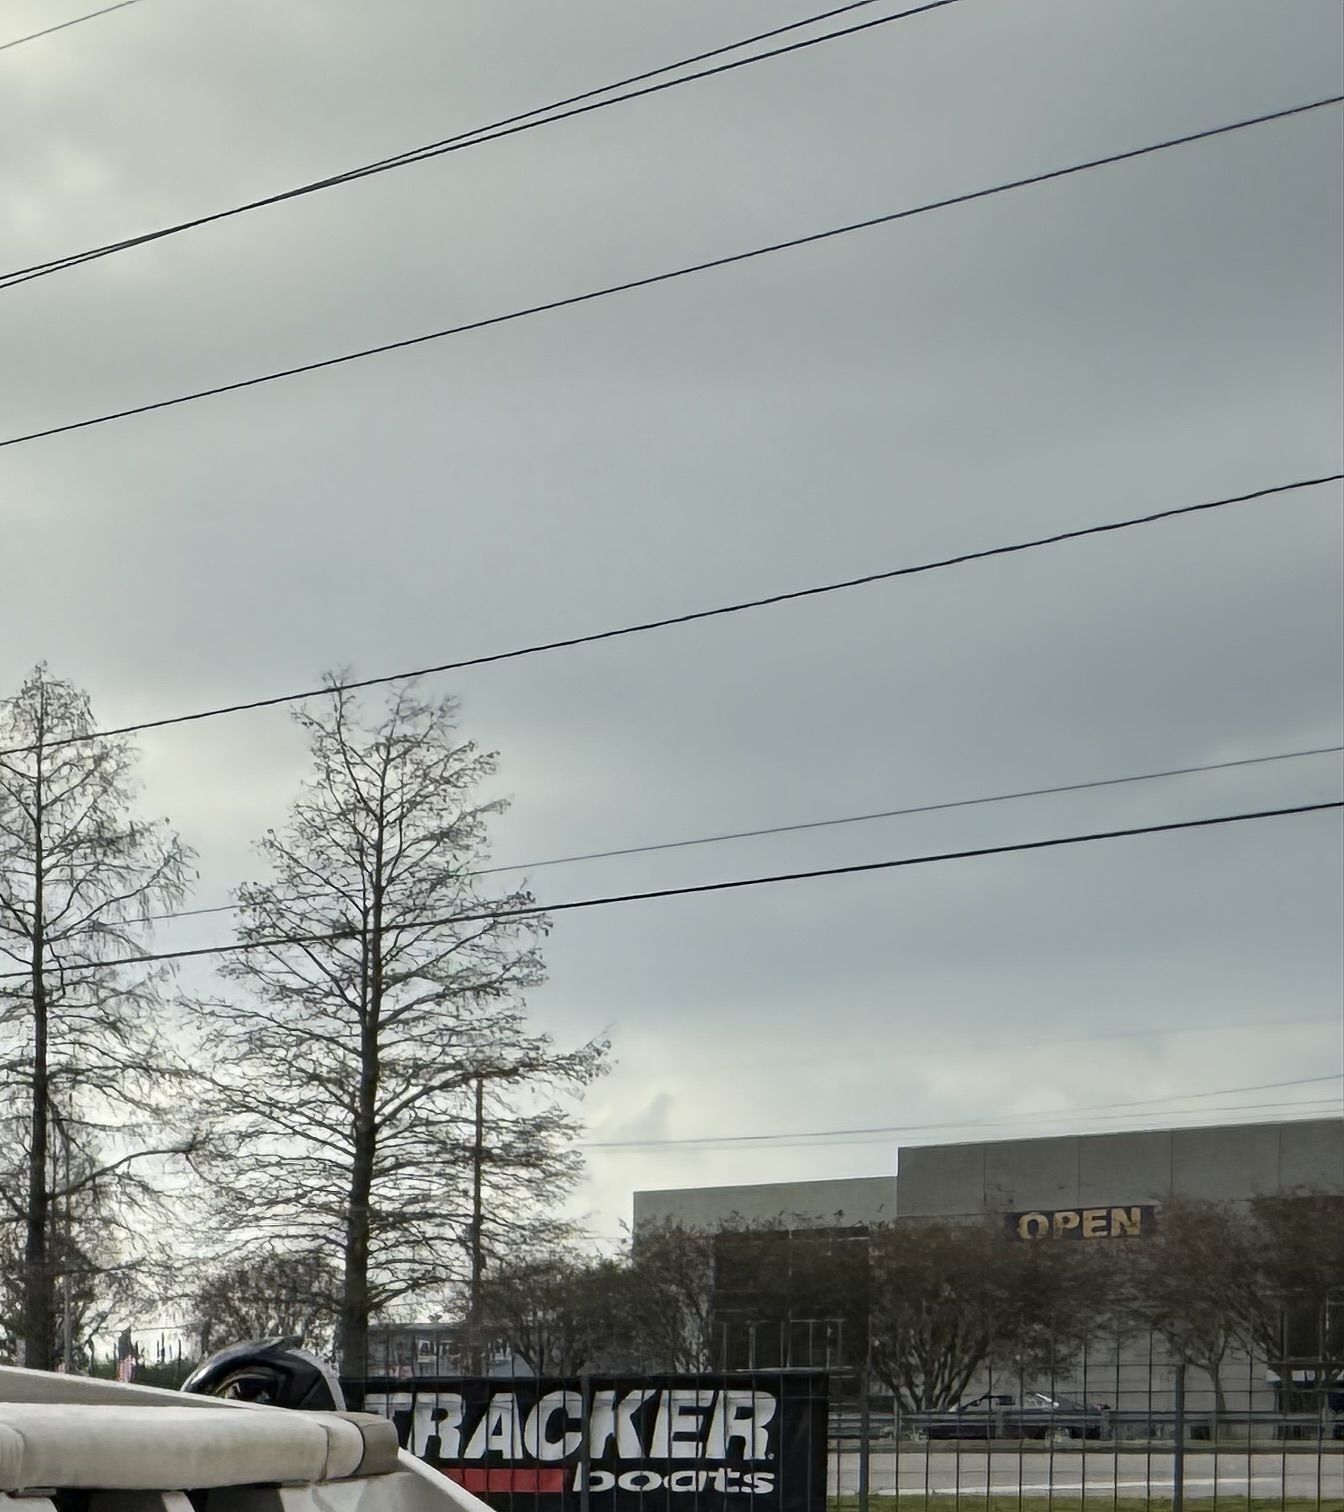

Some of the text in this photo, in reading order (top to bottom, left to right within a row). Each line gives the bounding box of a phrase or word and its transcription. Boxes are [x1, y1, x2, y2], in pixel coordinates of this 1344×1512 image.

[1017, 1207, 1142, 1240] OPEN
[364, 1389, 777, 1461] TRACKER
[572, 1461, 775, 1495] boats
